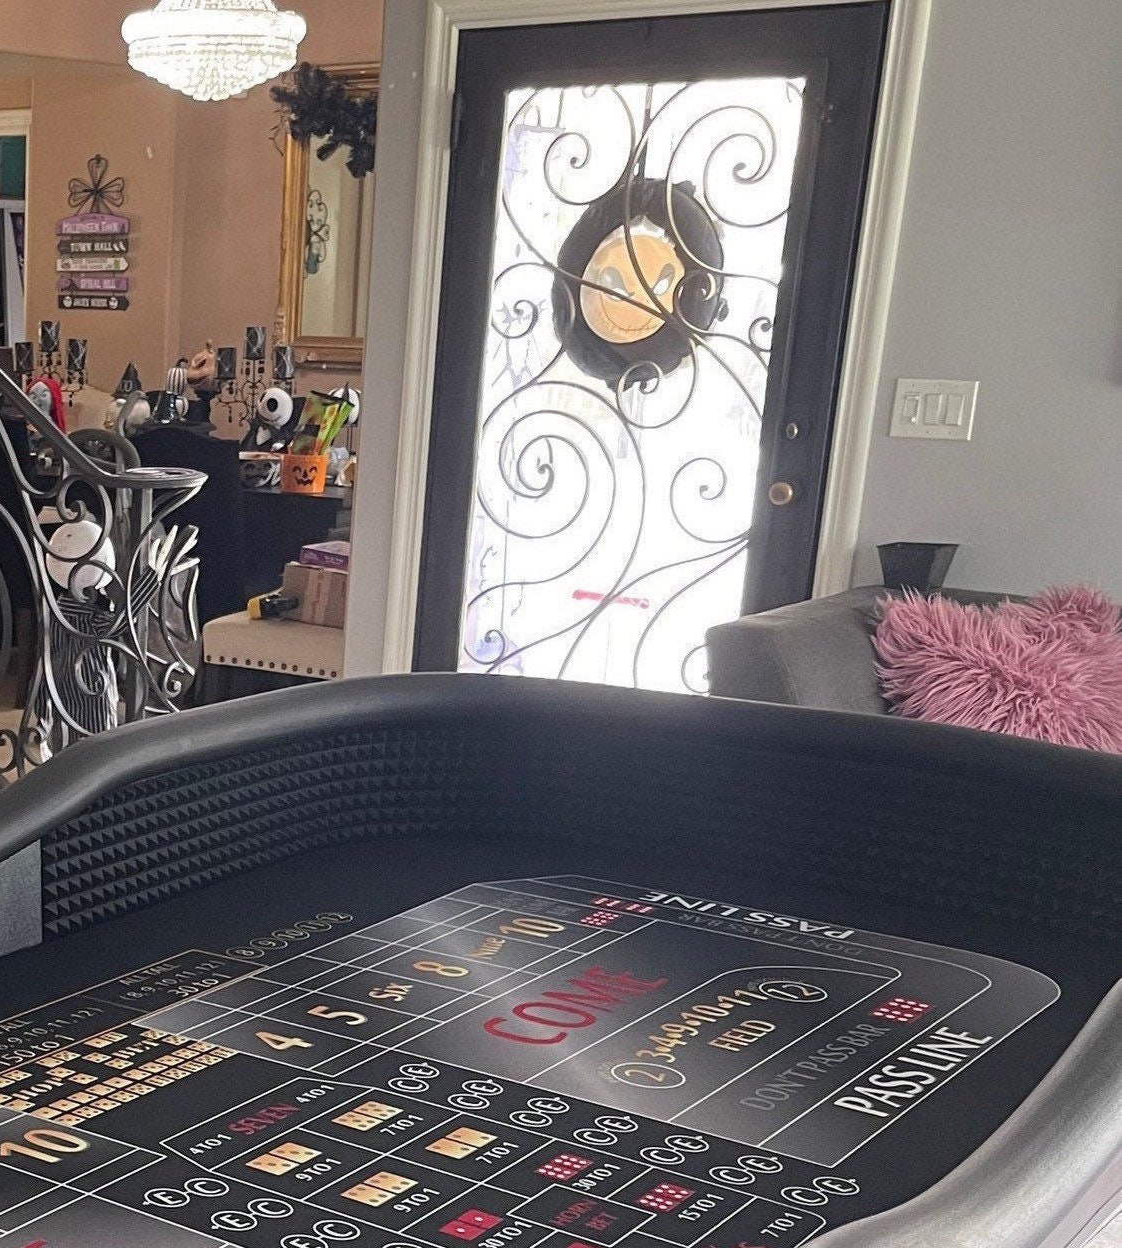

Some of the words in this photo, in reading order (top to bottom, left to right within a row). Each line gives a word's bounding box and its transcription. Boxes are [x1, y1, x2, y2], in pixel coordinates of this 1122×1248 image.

[639, 891, 740, 916] LINE
[499, 917, 566, 938] 10
[743, 912, 856, 940] PASS
[412, 961, 470, 978] 8
[307, 1005, 369, 1026] 5
[483, 966, 668, 1046] COME
[31, 1040, 60, 1052] to
[255, 1030, 314, 1051] 4
[707, 1020, 776, 1052] FIELD
[796, 1043, 857, 1074] PASS
[836, 1023, 892, 1047] BAR
[624, 1069, 665, 1083] 2
[833, 1065, 937, 1118] PASS
[897, 1026, 994, 1072] LINE
[0, 1128, 91, 1164] 10
